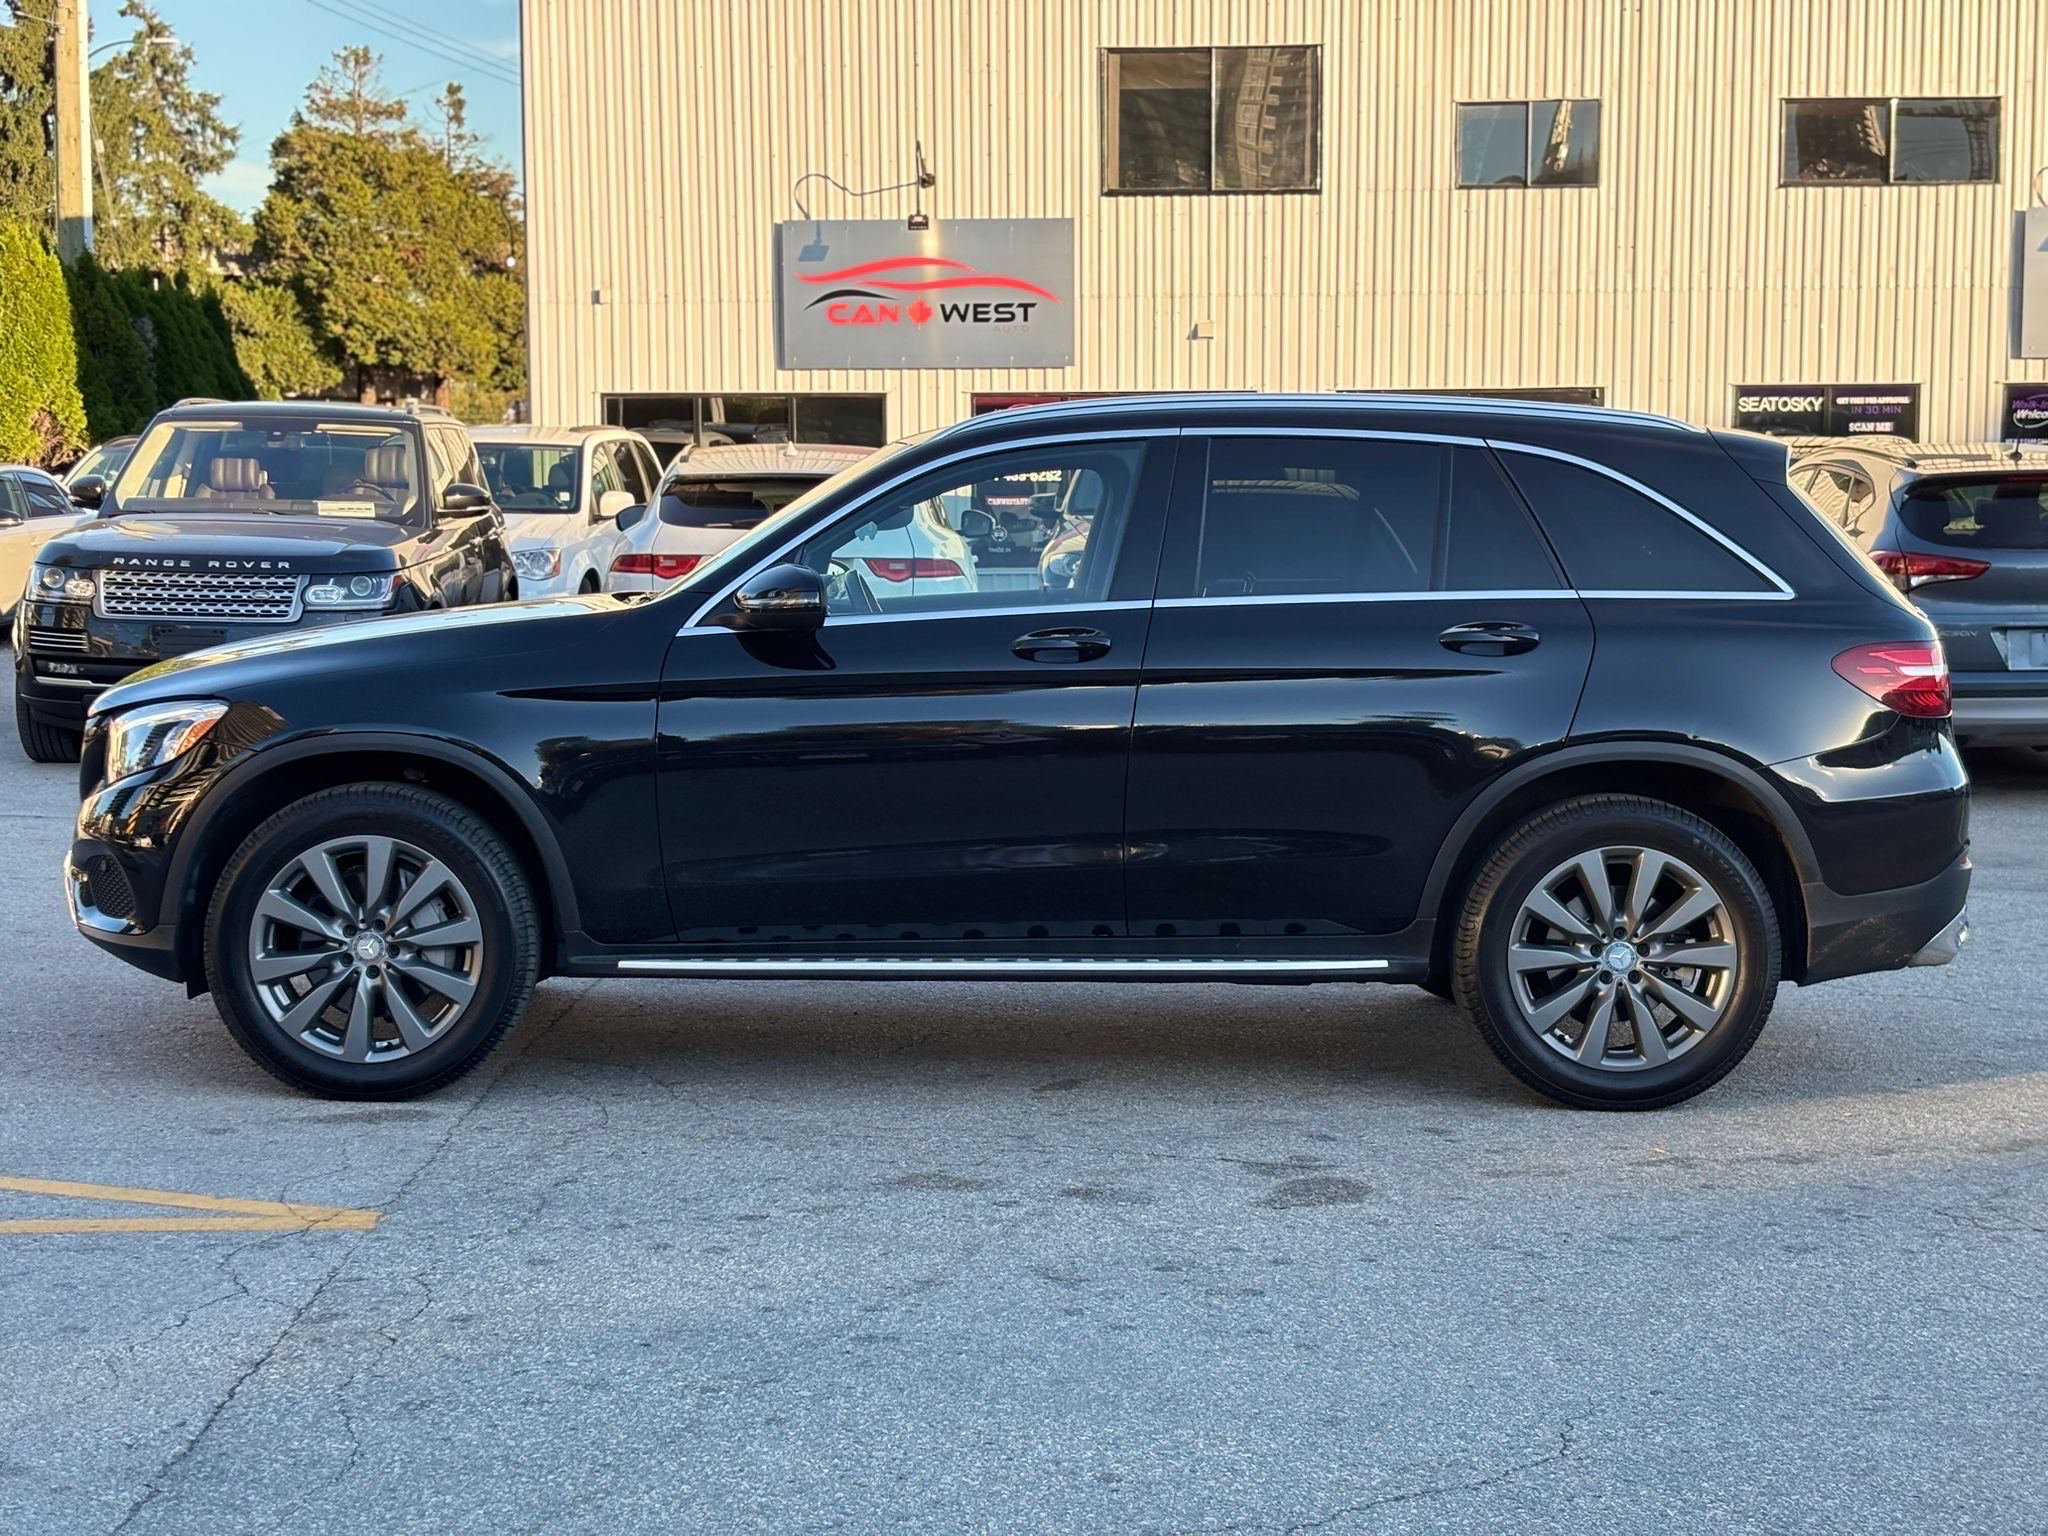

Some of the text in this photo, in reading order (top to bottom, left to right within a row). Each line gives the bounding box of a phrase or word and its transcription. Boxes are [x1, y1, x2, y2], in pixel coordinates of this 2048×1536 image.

[826, 302, 1038, 326] CAN WEST
[992, 324, 1031, 333] AUTO
[1737, 396, 1824, 413] SEATOSKY
[1851, 405, 1903, 415] IN 30 MIN
[1849, 422, 1875, 433] SCAN
[112, 556, 292, 570] RANGE ROVER
